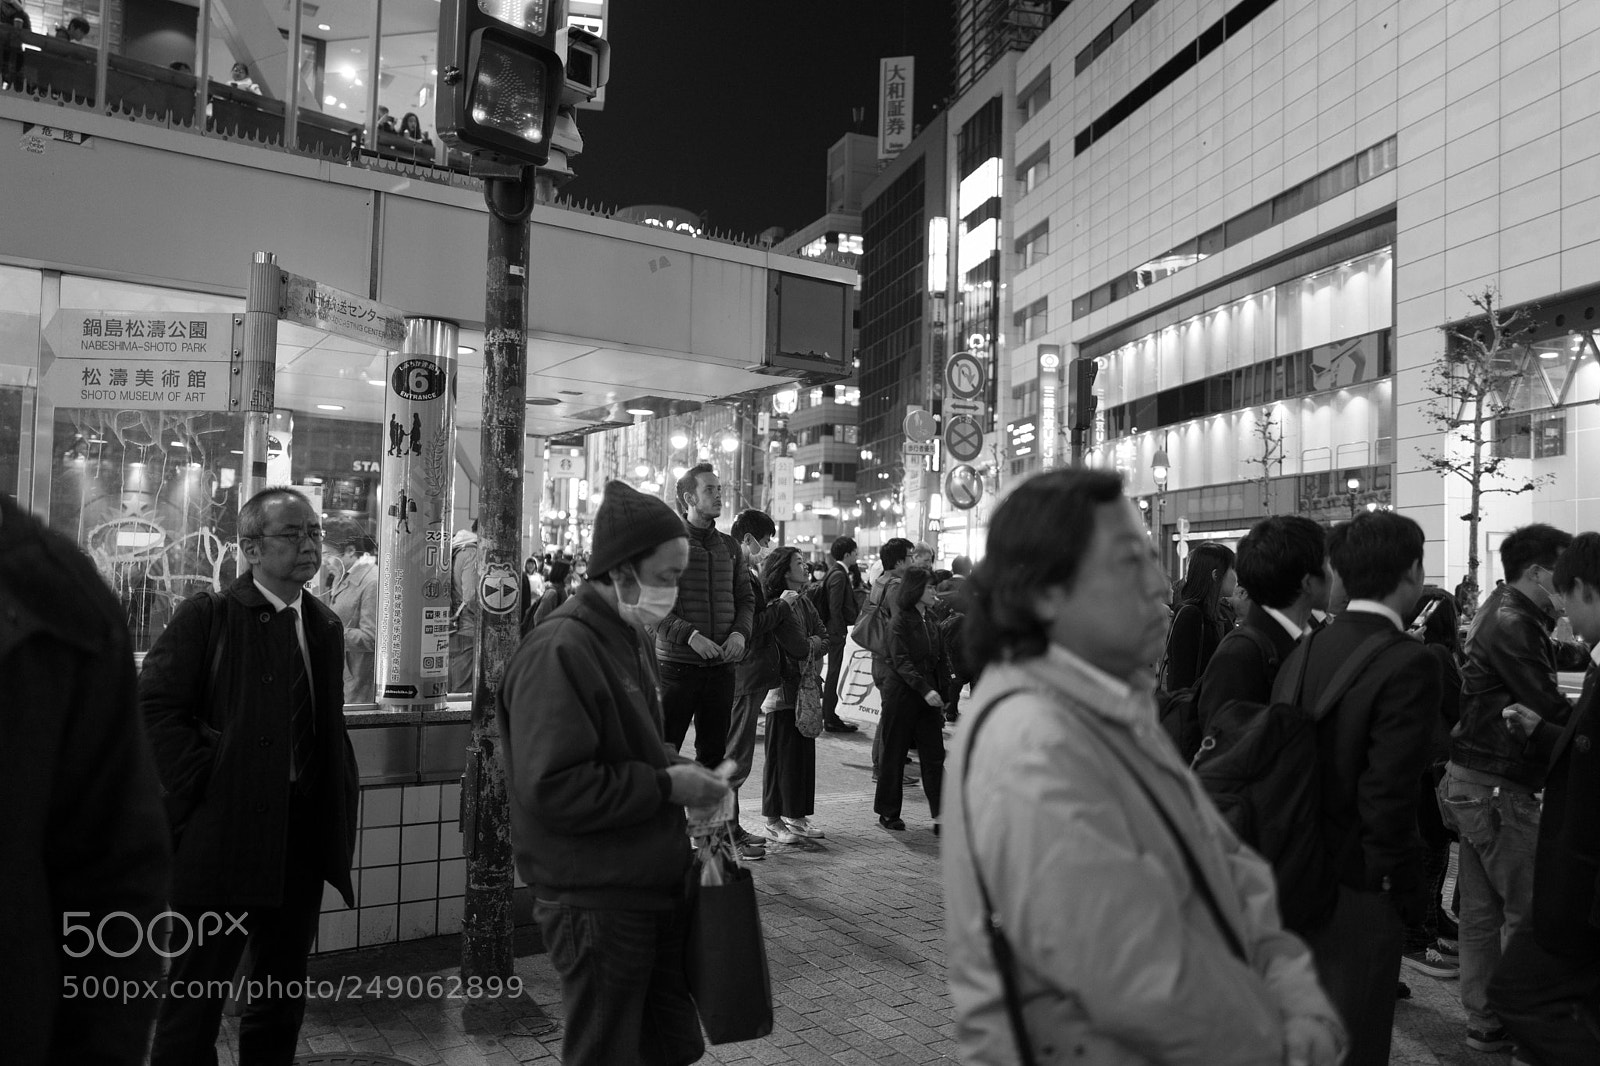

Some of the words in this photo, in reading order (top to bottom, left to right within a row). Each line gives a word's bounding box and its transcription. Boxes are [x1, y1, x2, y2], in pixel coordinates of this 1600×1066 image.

[887, 65, 906, 135] 大和証券
[82, 318, 208, 340] 鍋島松濤公園
[81, 340, 177, 352] NABESHIMA-SHOTO
[181, 343, 207, 353] PARK
[82, 366, 207, 388] 松濤美術館
[408, 368, 429, 393] 6
[81, 389, 117, 401] SHOTO
[119, 391, 164, 402] MUSEUM
[167, 391, 181, 402] OF
[184, 392, 206, 403] ART
[400, 390, 437, 400] ENTRANCE
[352, 460, 380, 472] STA
[858, 705, 879, 715] TOKYU
